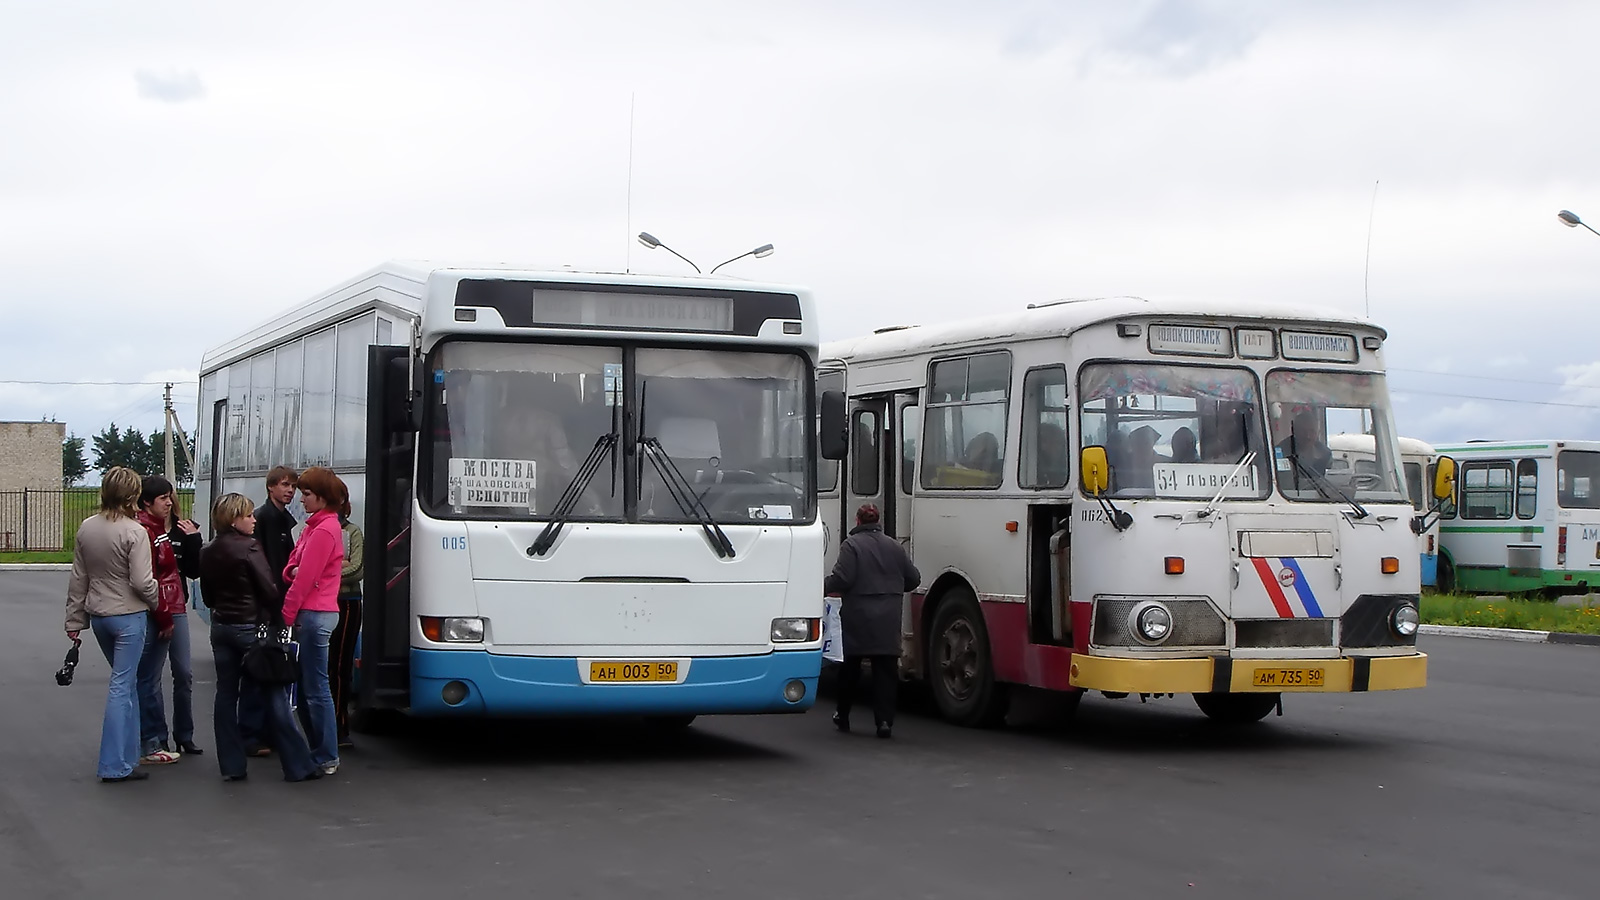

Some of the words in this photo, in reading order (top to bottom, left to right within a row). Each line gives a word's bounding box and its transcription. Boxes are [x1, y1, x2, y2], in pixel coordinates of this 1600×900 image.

[1288, 335, 1348, 351] ВОЛОКОЛАМСК
[463, 460, 534, 479] МОСКВА
[466, 479, 531, 489] ШАХОВСКАЯ
[1158, 469, 1178, 490] 54
[467, 490, 529, 503] РЕПОТИН
[442, 536, 466, 550] 005
[598, 667, 616, 679] АН
[623, 664, 650, 679] 003
[658, 664, 672, 674] 50
[1260, 673, 1275, 684] АМ
[1280, 670, 1302, 684] 735
[1308, 670, 1320, 680] 50
